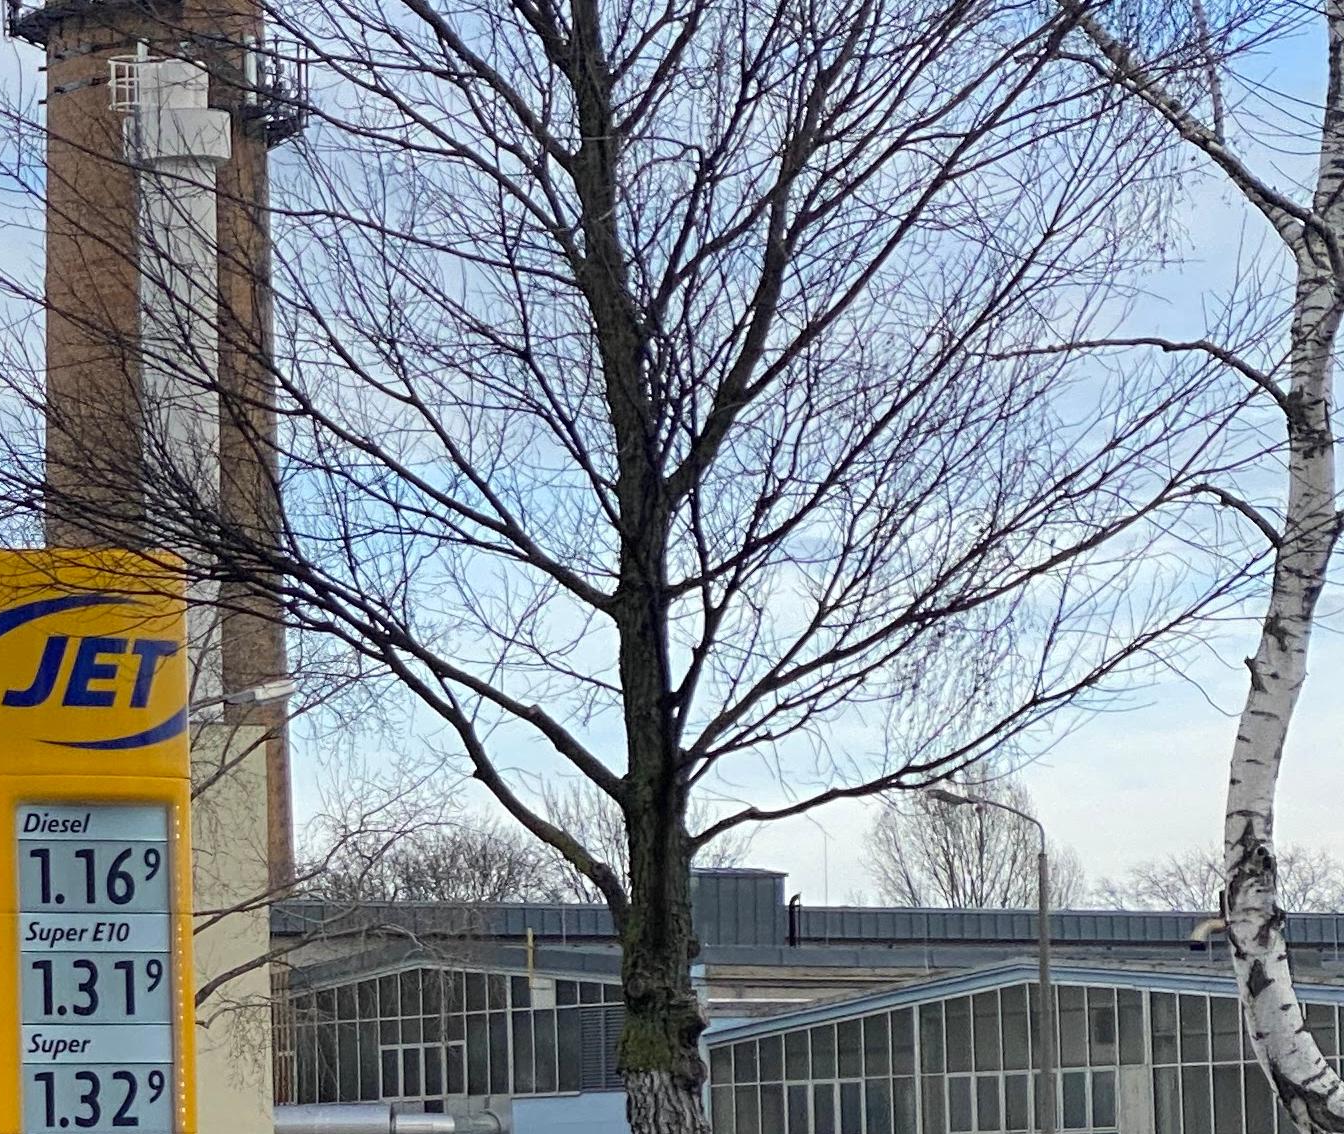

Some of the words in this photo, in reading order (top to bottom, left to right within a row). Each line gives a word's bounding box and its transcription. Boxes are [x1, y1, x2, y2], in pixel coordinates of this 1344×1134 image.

[1, 635, 179, 709] JET
[23, 813, 91, 833] Diesel
[26, 922, 88, 948] Super
[92, 922, 130, 942] E10
[28, 1034, 91, 1060] Super
